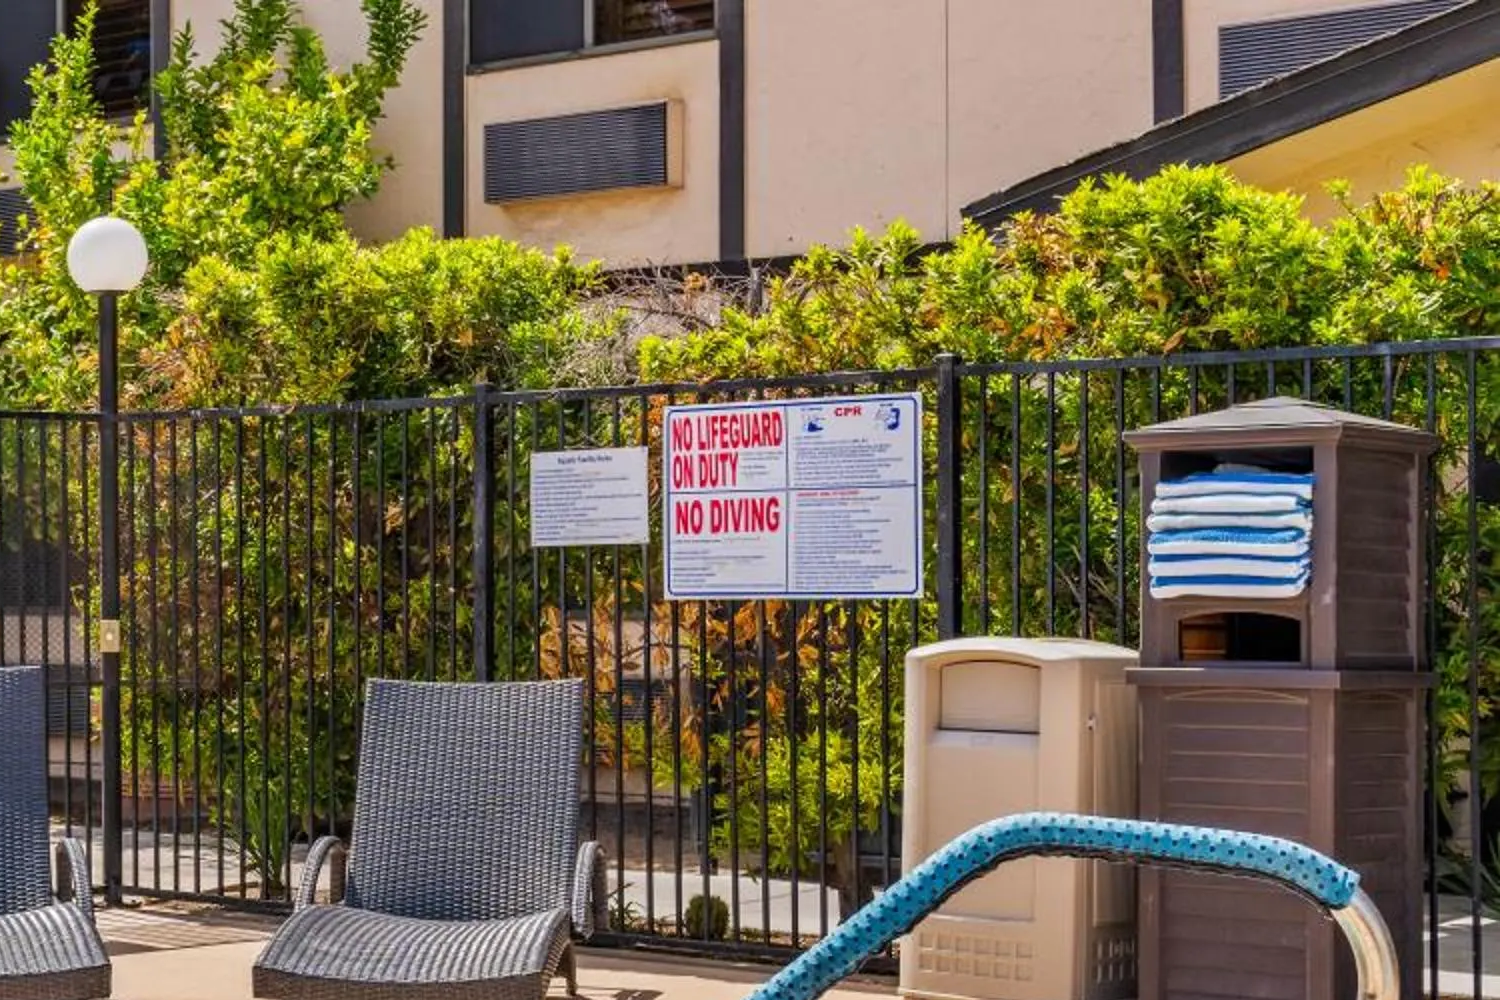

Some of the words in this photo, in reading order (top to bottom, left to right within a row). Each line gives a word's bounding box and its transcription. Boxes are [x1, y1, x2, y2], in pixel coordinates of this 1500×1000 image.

[834, 405, 862, 417] CPR
[672, 416, 693, 451] NO
[697, 411, 783, 451] LIFEGUARD
[673, 454, 694, 489] ON
[699, 452, 739, 489] DUTY
[675, 499, 704, 535] NO
[709, 496, 781, 535] DIVING
